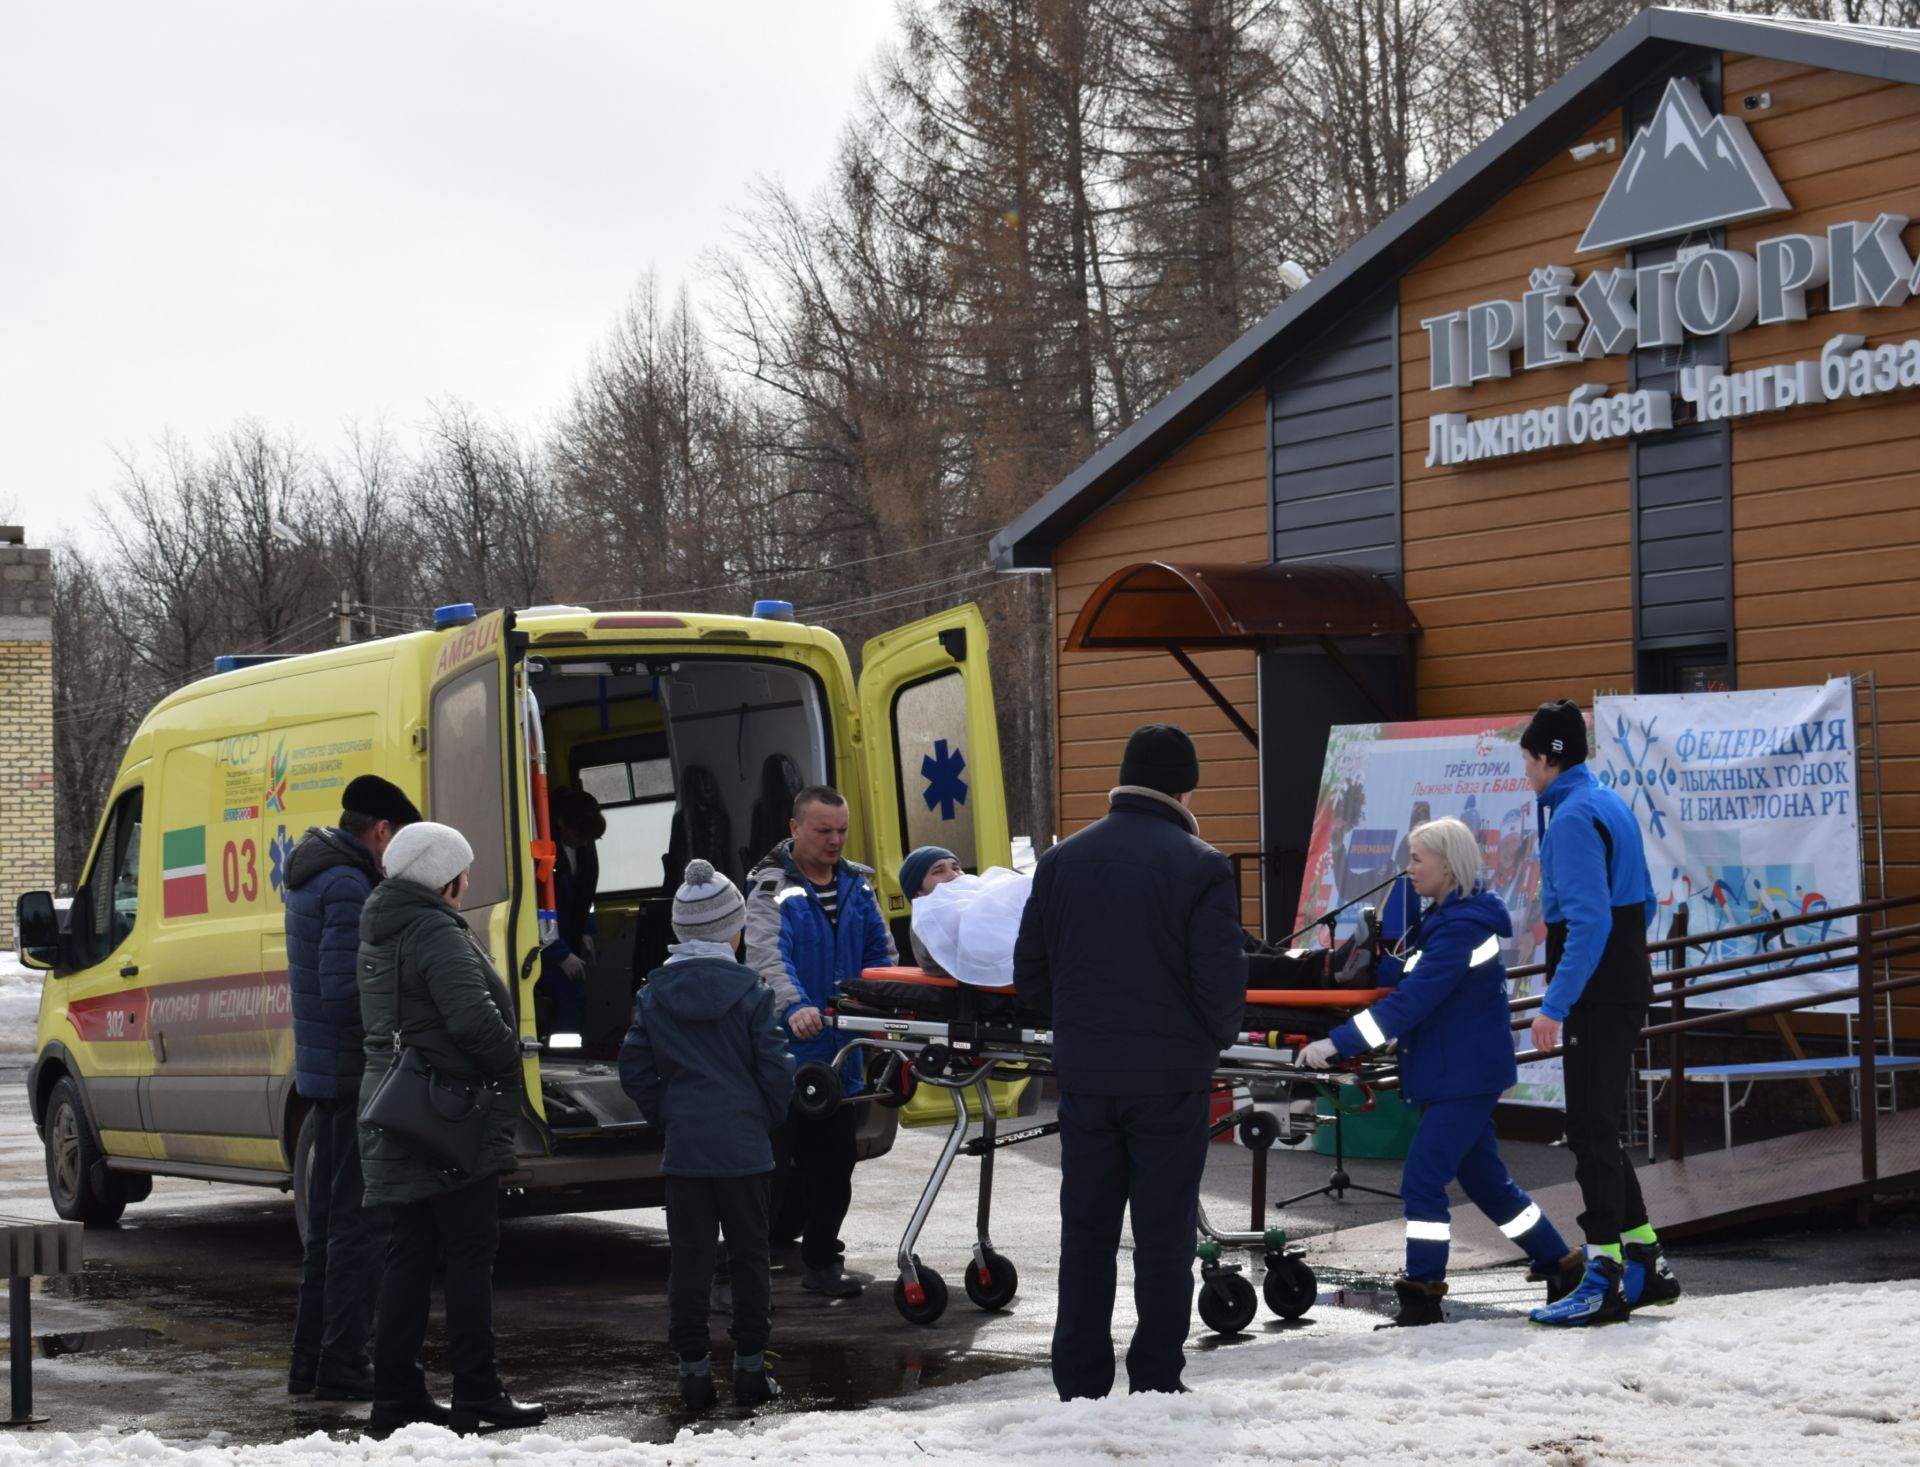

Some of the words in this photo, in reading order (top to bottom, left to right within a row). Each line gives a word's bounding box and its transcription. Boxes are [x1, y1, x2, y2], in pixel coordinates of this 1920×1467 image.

[1421, 212, 1920, 391] ТРЁХГОРК
[1425, 406, 1562, 468] Лыжная
[1568, 384, 1655, 445] база
[1680, 361, 1806, 422] Чангы
[1821, 334, 1920, 400] база
[1676, 719, 1847, 764] ФЕДЕРАЦИЯ
[1444, 760, 1510, 778] ТРЁХГОРКА
[1680, 768, 1770, 792] ЛЫЖНЫХ
[1774, 761, 1849, 787] ГОНОК
[1411, 781, 1453, 796] Лыжная
[1455, 780, 1480, 794] База
[1680, 798, 1693, 821] И
[1698, 793, 1815, 821] БИАТЛОНА
[1821, 791, 1849, 815] РТ
[223, 838, 258, 903] 03
[150, 991, 200, 1024] СКОРАЯ
[106, 1010, 124, 1037] 302
[995, 1127, 1044, 1145] SPENCER
